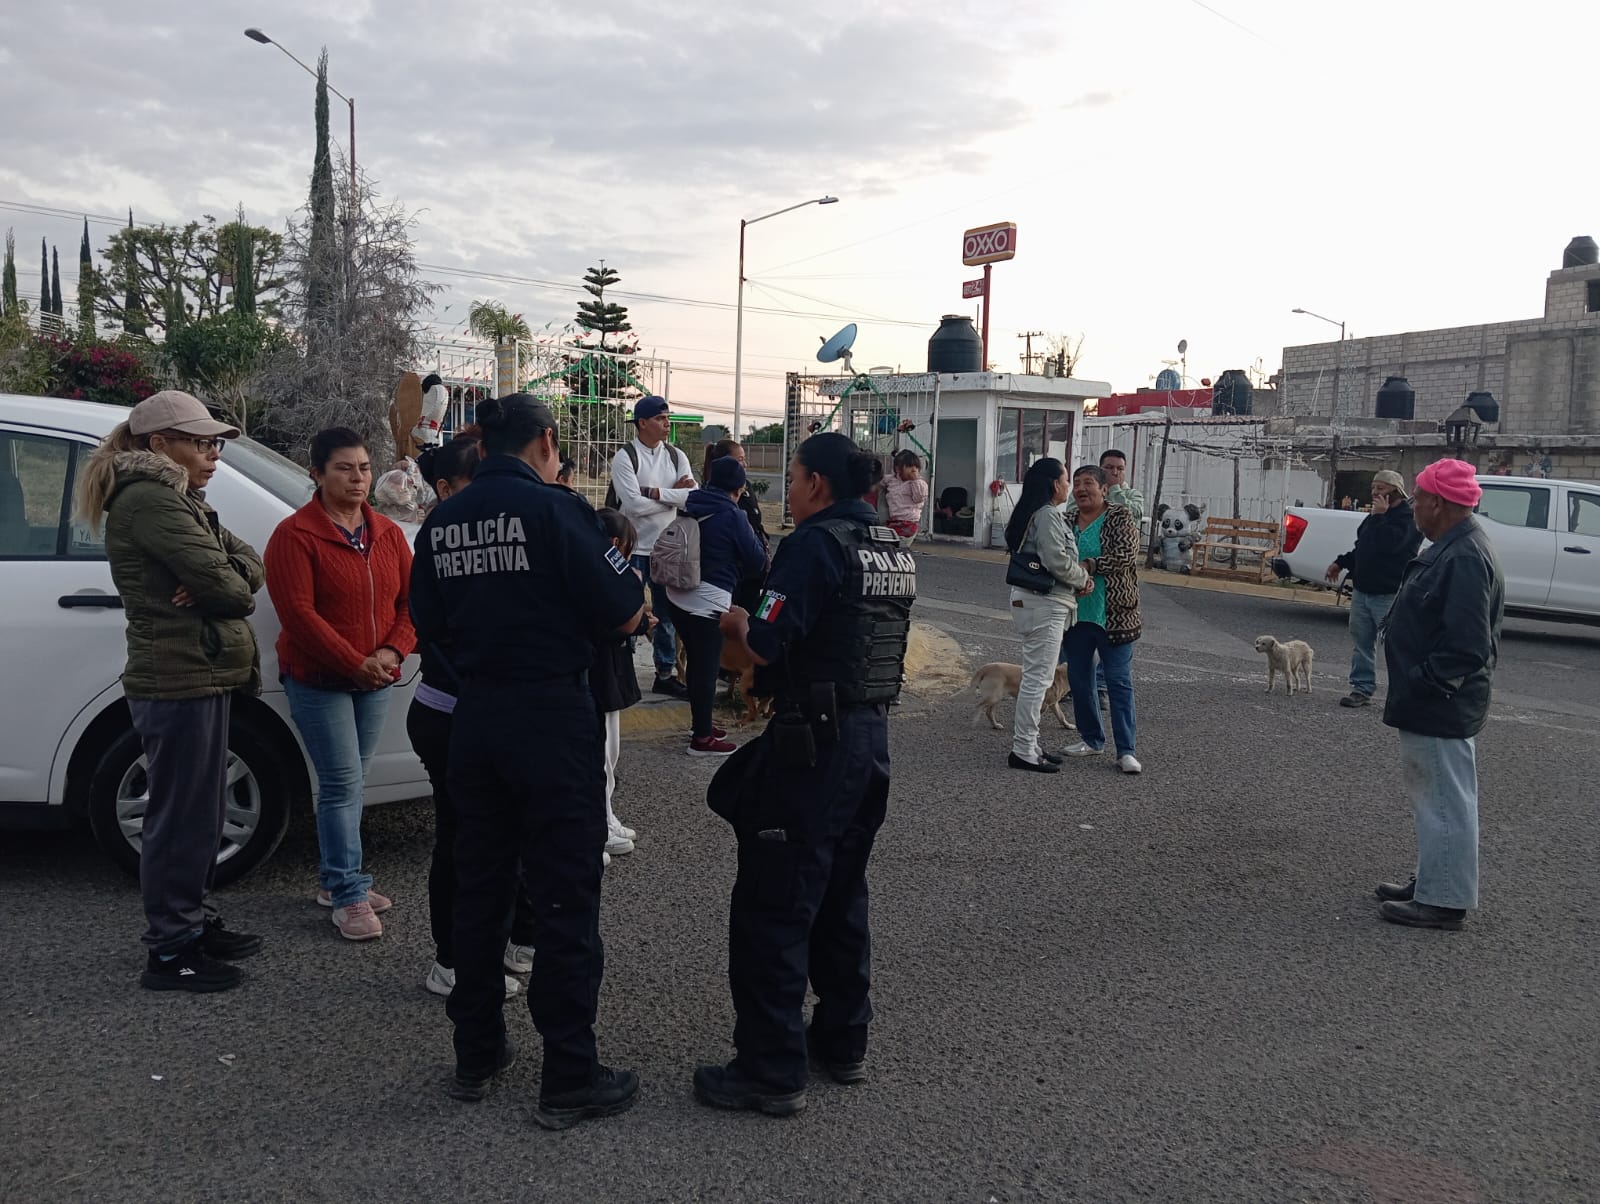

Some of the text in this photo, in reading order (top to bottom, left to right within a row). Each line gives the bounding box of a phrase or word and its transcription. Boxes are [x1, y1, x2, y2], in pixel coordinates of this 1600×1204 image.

[964, 230, 1008, 256] OXXO
[430, 512, 527, 552] POLICÍA
[861, 572, 916, 596] PREVENTIV
